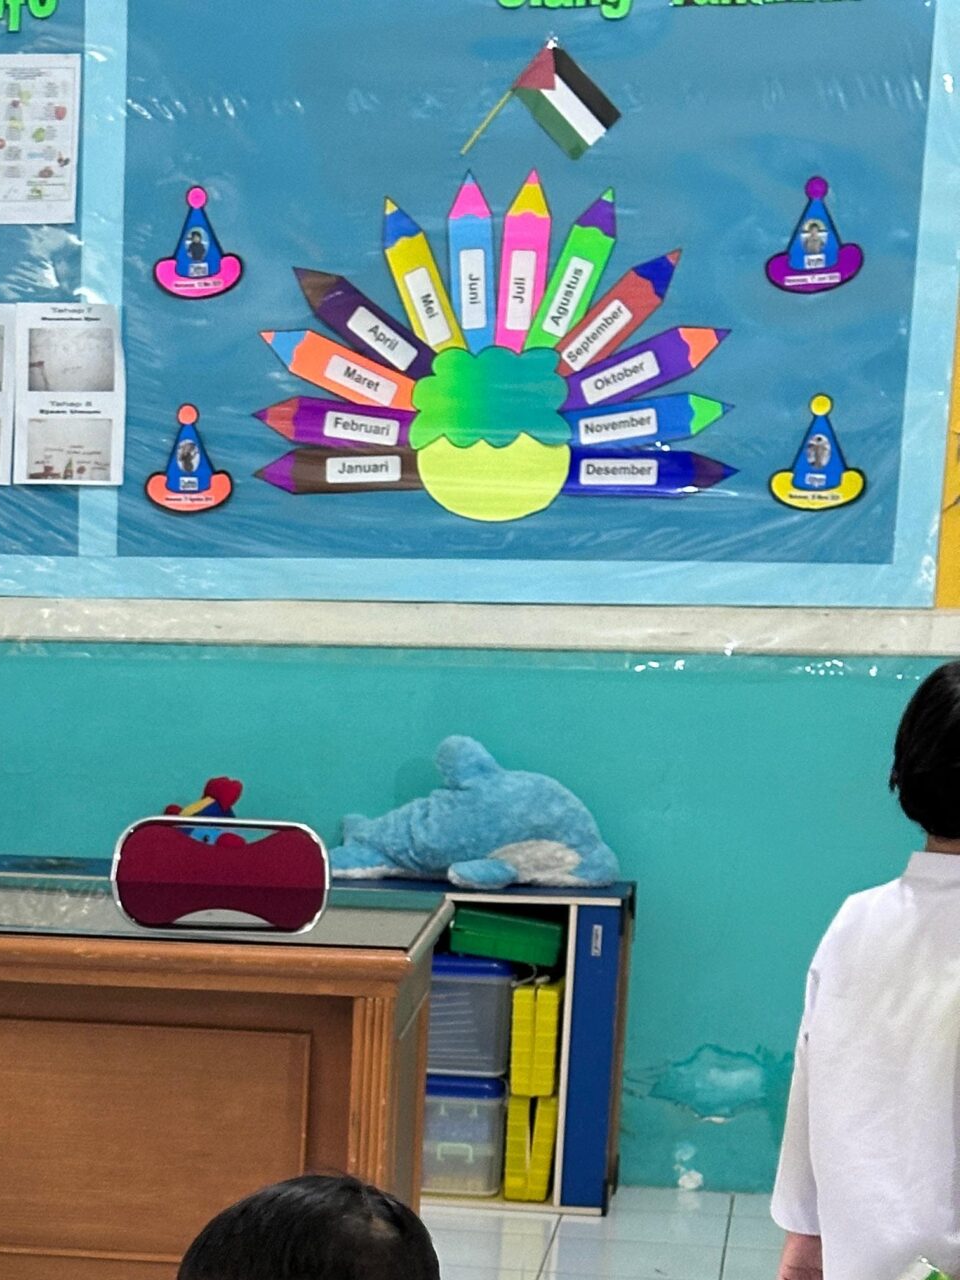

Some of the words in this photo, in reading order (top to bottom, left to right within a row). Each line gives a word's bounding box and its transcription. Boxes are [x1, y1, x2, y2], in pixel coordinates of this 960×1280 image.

[467, 273, 481, 305] Juni
[512, 277, 527, 304] Juli
[549, 268, 584, 327] Agustus
[420, 293, 438, 319] Mei
[367, 324, 399, 351] April
[566, 305, 624, 363] September
[343, 366, 380, 392] Maret
[593, 361, 645, 391] Oktober
[333, 417, 390, 437] Februari
[584, 415, 652, 434] November
[337, 461, 389, 474] Januari
[586, 464, 653, 476] Desember
